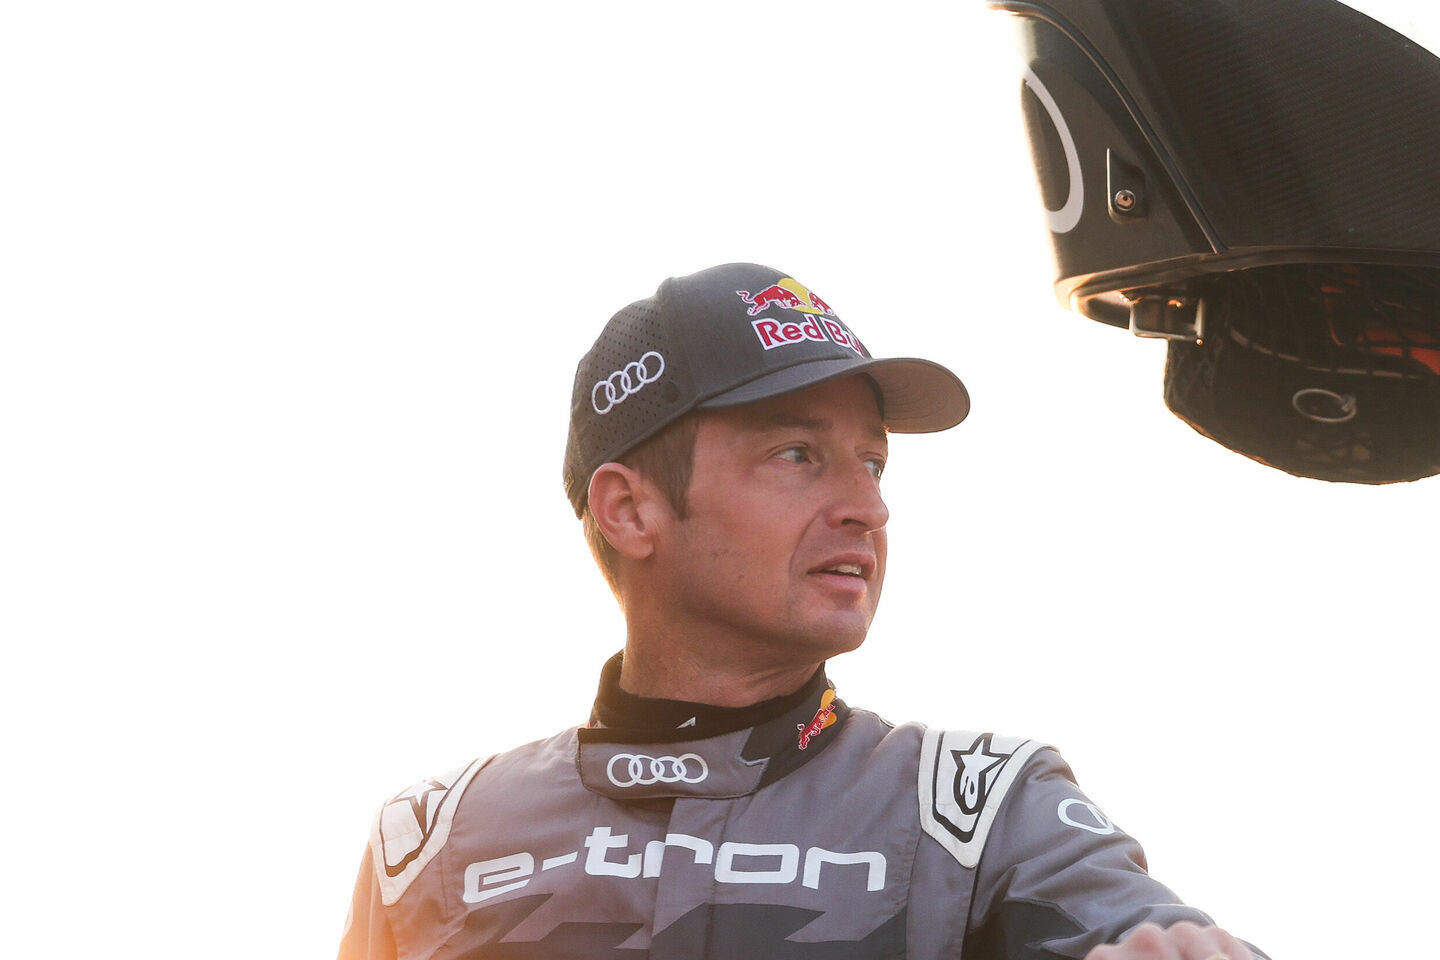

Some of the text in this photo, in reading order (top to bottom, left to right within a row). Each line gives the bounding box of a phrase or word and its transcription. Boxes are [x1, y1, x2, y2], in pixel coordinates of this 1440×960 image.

[751, 314, 867, 359] Red Bu
[463, 826, 887, 904] e-tron
